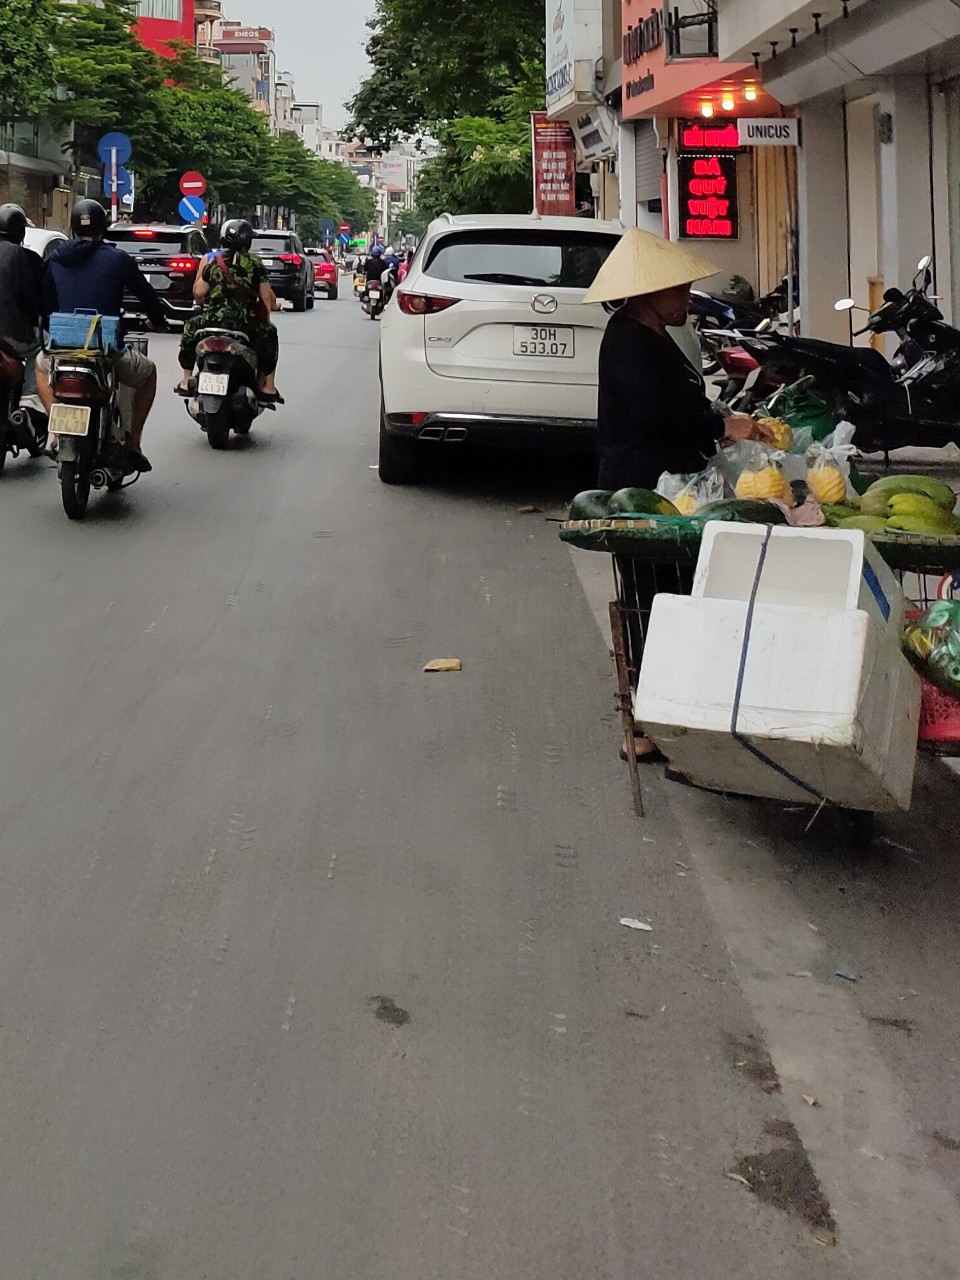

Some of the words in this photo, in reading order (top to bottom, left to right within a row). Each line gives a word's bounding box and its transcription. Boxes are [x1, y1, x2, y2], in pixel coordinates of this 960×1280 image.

[747, 124, 790, 139] UNICUS
[689, 176, 727, 195] QUÝ
[687, 197, 729, 218] VIỆT
[686, 219, 732, 235] NAM
[531, 328, 556, 340] 30H
[520, 343, 567, 355] 533.07
